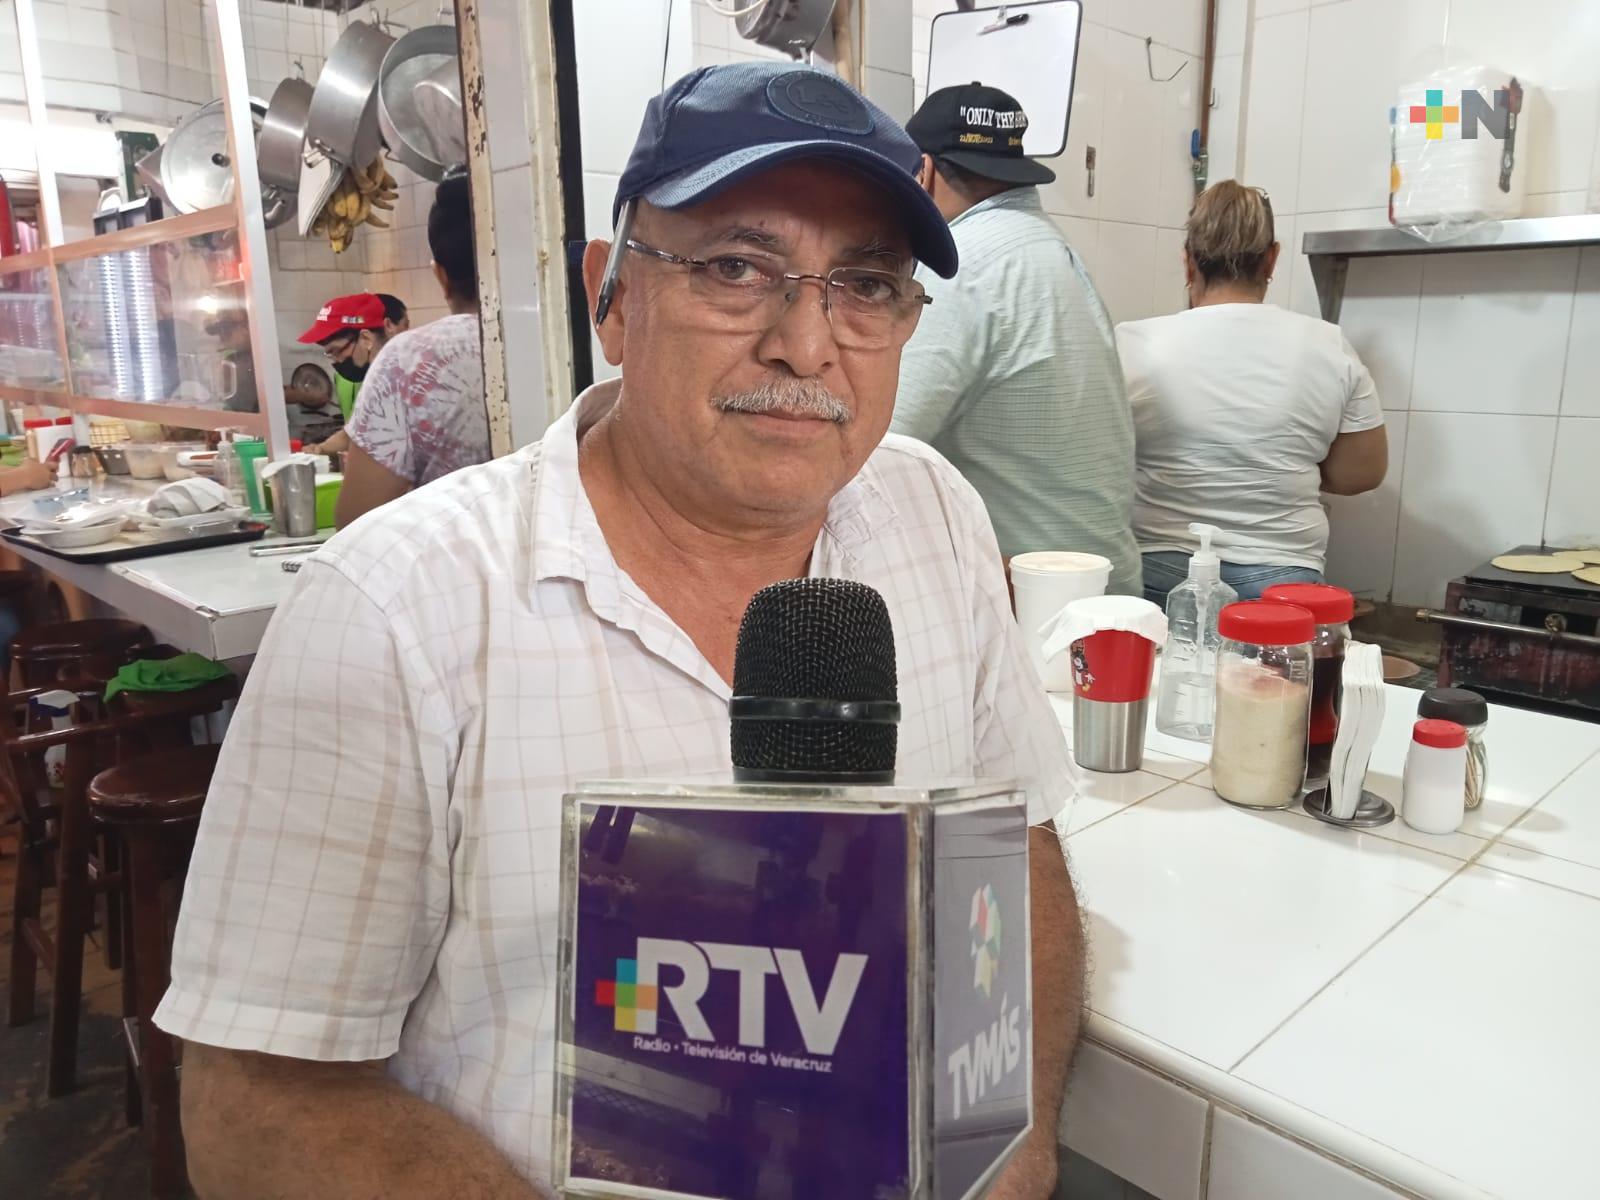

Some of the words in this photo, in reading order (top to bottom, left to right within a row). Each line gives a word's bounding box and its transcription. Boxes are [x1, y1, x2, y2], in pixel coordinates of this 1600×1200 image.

[995, 112, 1014, 128] THE
[637, 936, 868, 1056] RTV
[633, 1036, 671, 1053] Radio
[683, 1041, 746, 1063] Televisión
[749, 1049, 767, 1065] de
[771, 1052, 832, 1073] Veracruz
